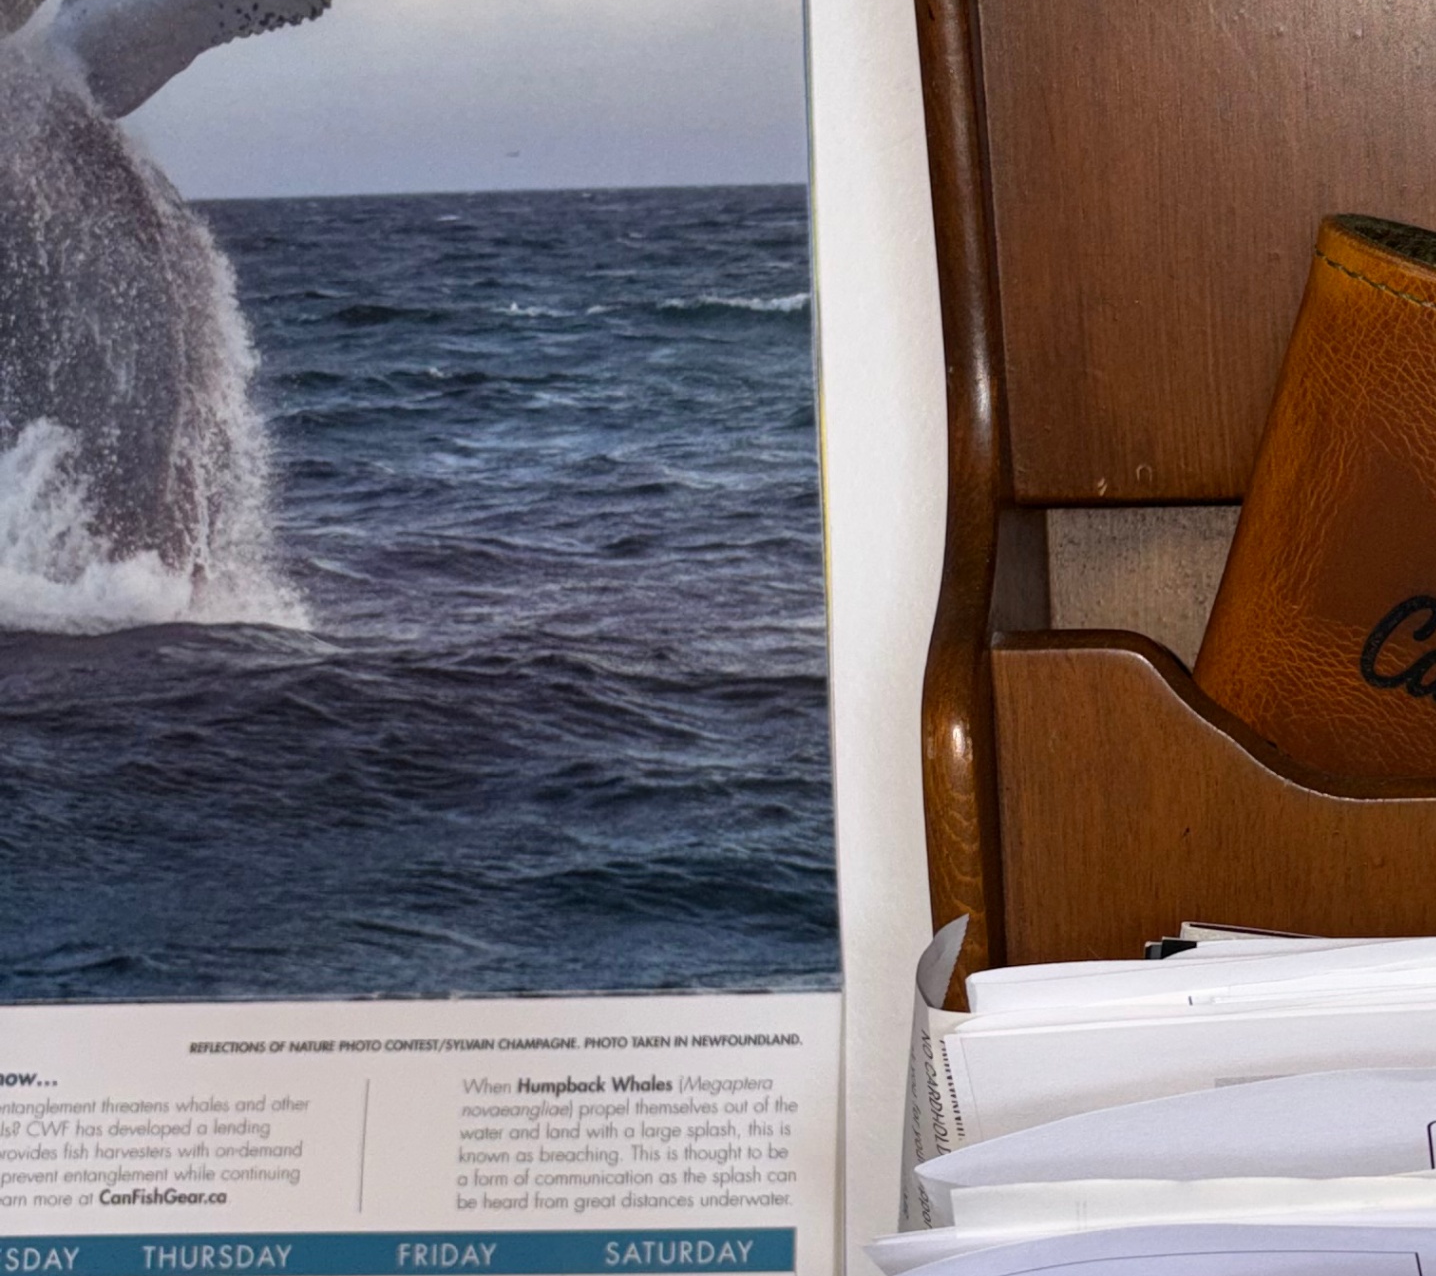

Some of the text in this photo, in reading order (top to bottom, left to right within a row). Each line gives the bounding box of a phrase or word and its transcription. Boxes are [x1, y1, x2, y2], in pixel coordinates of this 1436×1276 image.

[190, 1042, 266, 1053] REFLECTIONS
[269, 1041, 286, 1053] OF
[289, 1041, 335, 1052] NATURE
[339, 1040, 382, 1052] PHOTO
[384, 1039, 494, 1052] CONTEST/SYLVAIN
[584, 1037, 628, 1049] PHOTO
[632, 1036, 670, 1048] TAKEN
[674, 1036, 688, 1047] IN
[692, 1034, 802, 1047] NEWFOUNDLAND.
[921, 1030, 933, 1062] NO
[463, 1077, 511, 1095] When
[518, 1076, 605, 1097] Humpback
[612, 1075, 672, 1092] Whales
[101, 1097, 169, 1113] threatens
[176, 1096, 230, 1112] whales
[235, 1095, 266, 1112] and
[271, 1096, 310, 1111] other
[578, 1098, 629, 1122] propel
[635, 1097, 718, 1115] themselves
[724, 1100, 748, 1114] out
[753, 1096, 769, 1113] of
[775, 1096, 798, 1113] the
[26, 1120, 71, 1138] CWF
[76, 1120, 102, 1137] has
[108, 1118, 192, 1140] developed
[197, 1124, 207, 1135] a
[213, 1118, 270, 1139] lending
[460, 1119, 791, 1143] water and land with a large splash, this is
[0, 1140, 303, 1162] rovides fish harvesters with on-demand
[458, 1143, 788, 1167] known as breaching. This is thought to be
[63, 1165, 168, 1187] entanglement
[174, 1164, 215, 1181] while
[220, 1167, 300, 1186] continuing
[457, 1166, 796, 1188] a form of communication as the splash can
[34, 1195, 72, 1206] more
[79, 1193, 93, 1206] at
[456, 1193, 477, 1210] be
[482, 1192, 529, 1210] heard
[534, 1191, 568, 1209] from
[574, 1195, 615, 1214] great
[621, 1191, 694, 1208] distances
[143, 1245, 291, 1269] THURSDAY
[399, 1243, 496, 1266] FRIDAY
[606, 1241, 753, 1265] SATURDAY
